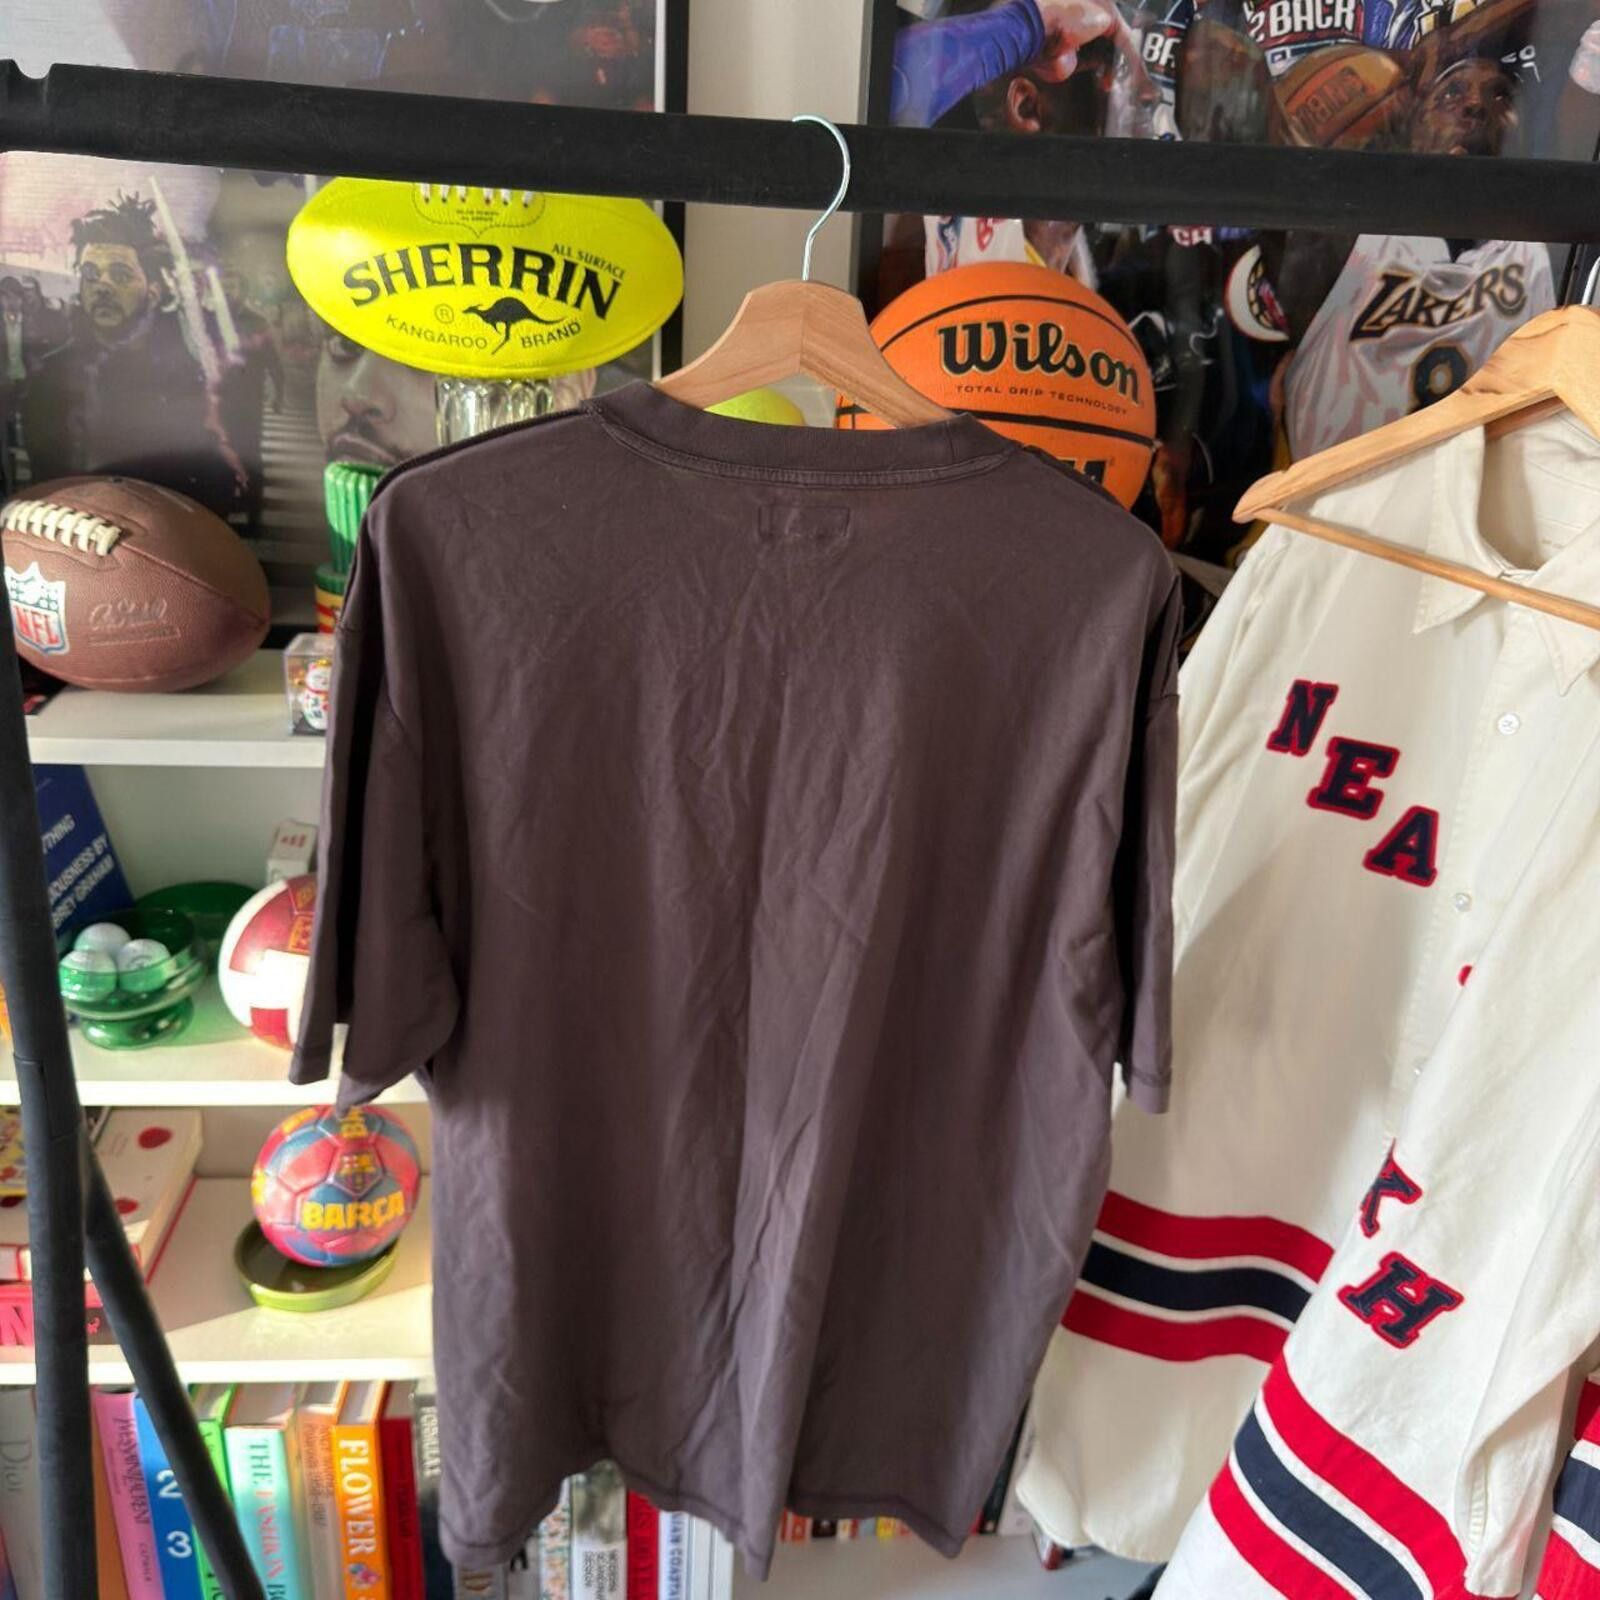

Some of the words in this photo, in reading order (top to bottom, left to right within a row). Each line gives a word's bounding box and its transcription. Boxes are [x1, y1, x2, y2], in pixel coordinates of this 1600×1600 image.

[342, 242, 624, 320] SHERRIN
[552, 242, 575, 258] ALL
[577, 249, 627, 279] SURFACE
[1349, 262, 1528, 343] LAKERS
[385, 313, 489, 350] KANGAROO
[520, 320, 582, 350] BRAND
[938, 320, 1142, 407] Wilson
[956, 385, 1002, 395] TOTAL
[1008, 386, 1044, 397] GRIP
[1050, 391, 1128, 415] TECHNOLOGY
[13, 604, 60, 645] NFL
[302, 1189, 405, 1231] BARÇA
[249, 1440, 273, 1485] THE
[157, 1469, 182, 1498] 2
[339, 1439, 376, 1556] FLOWER
[166, 1530, 193, 1558] 3
